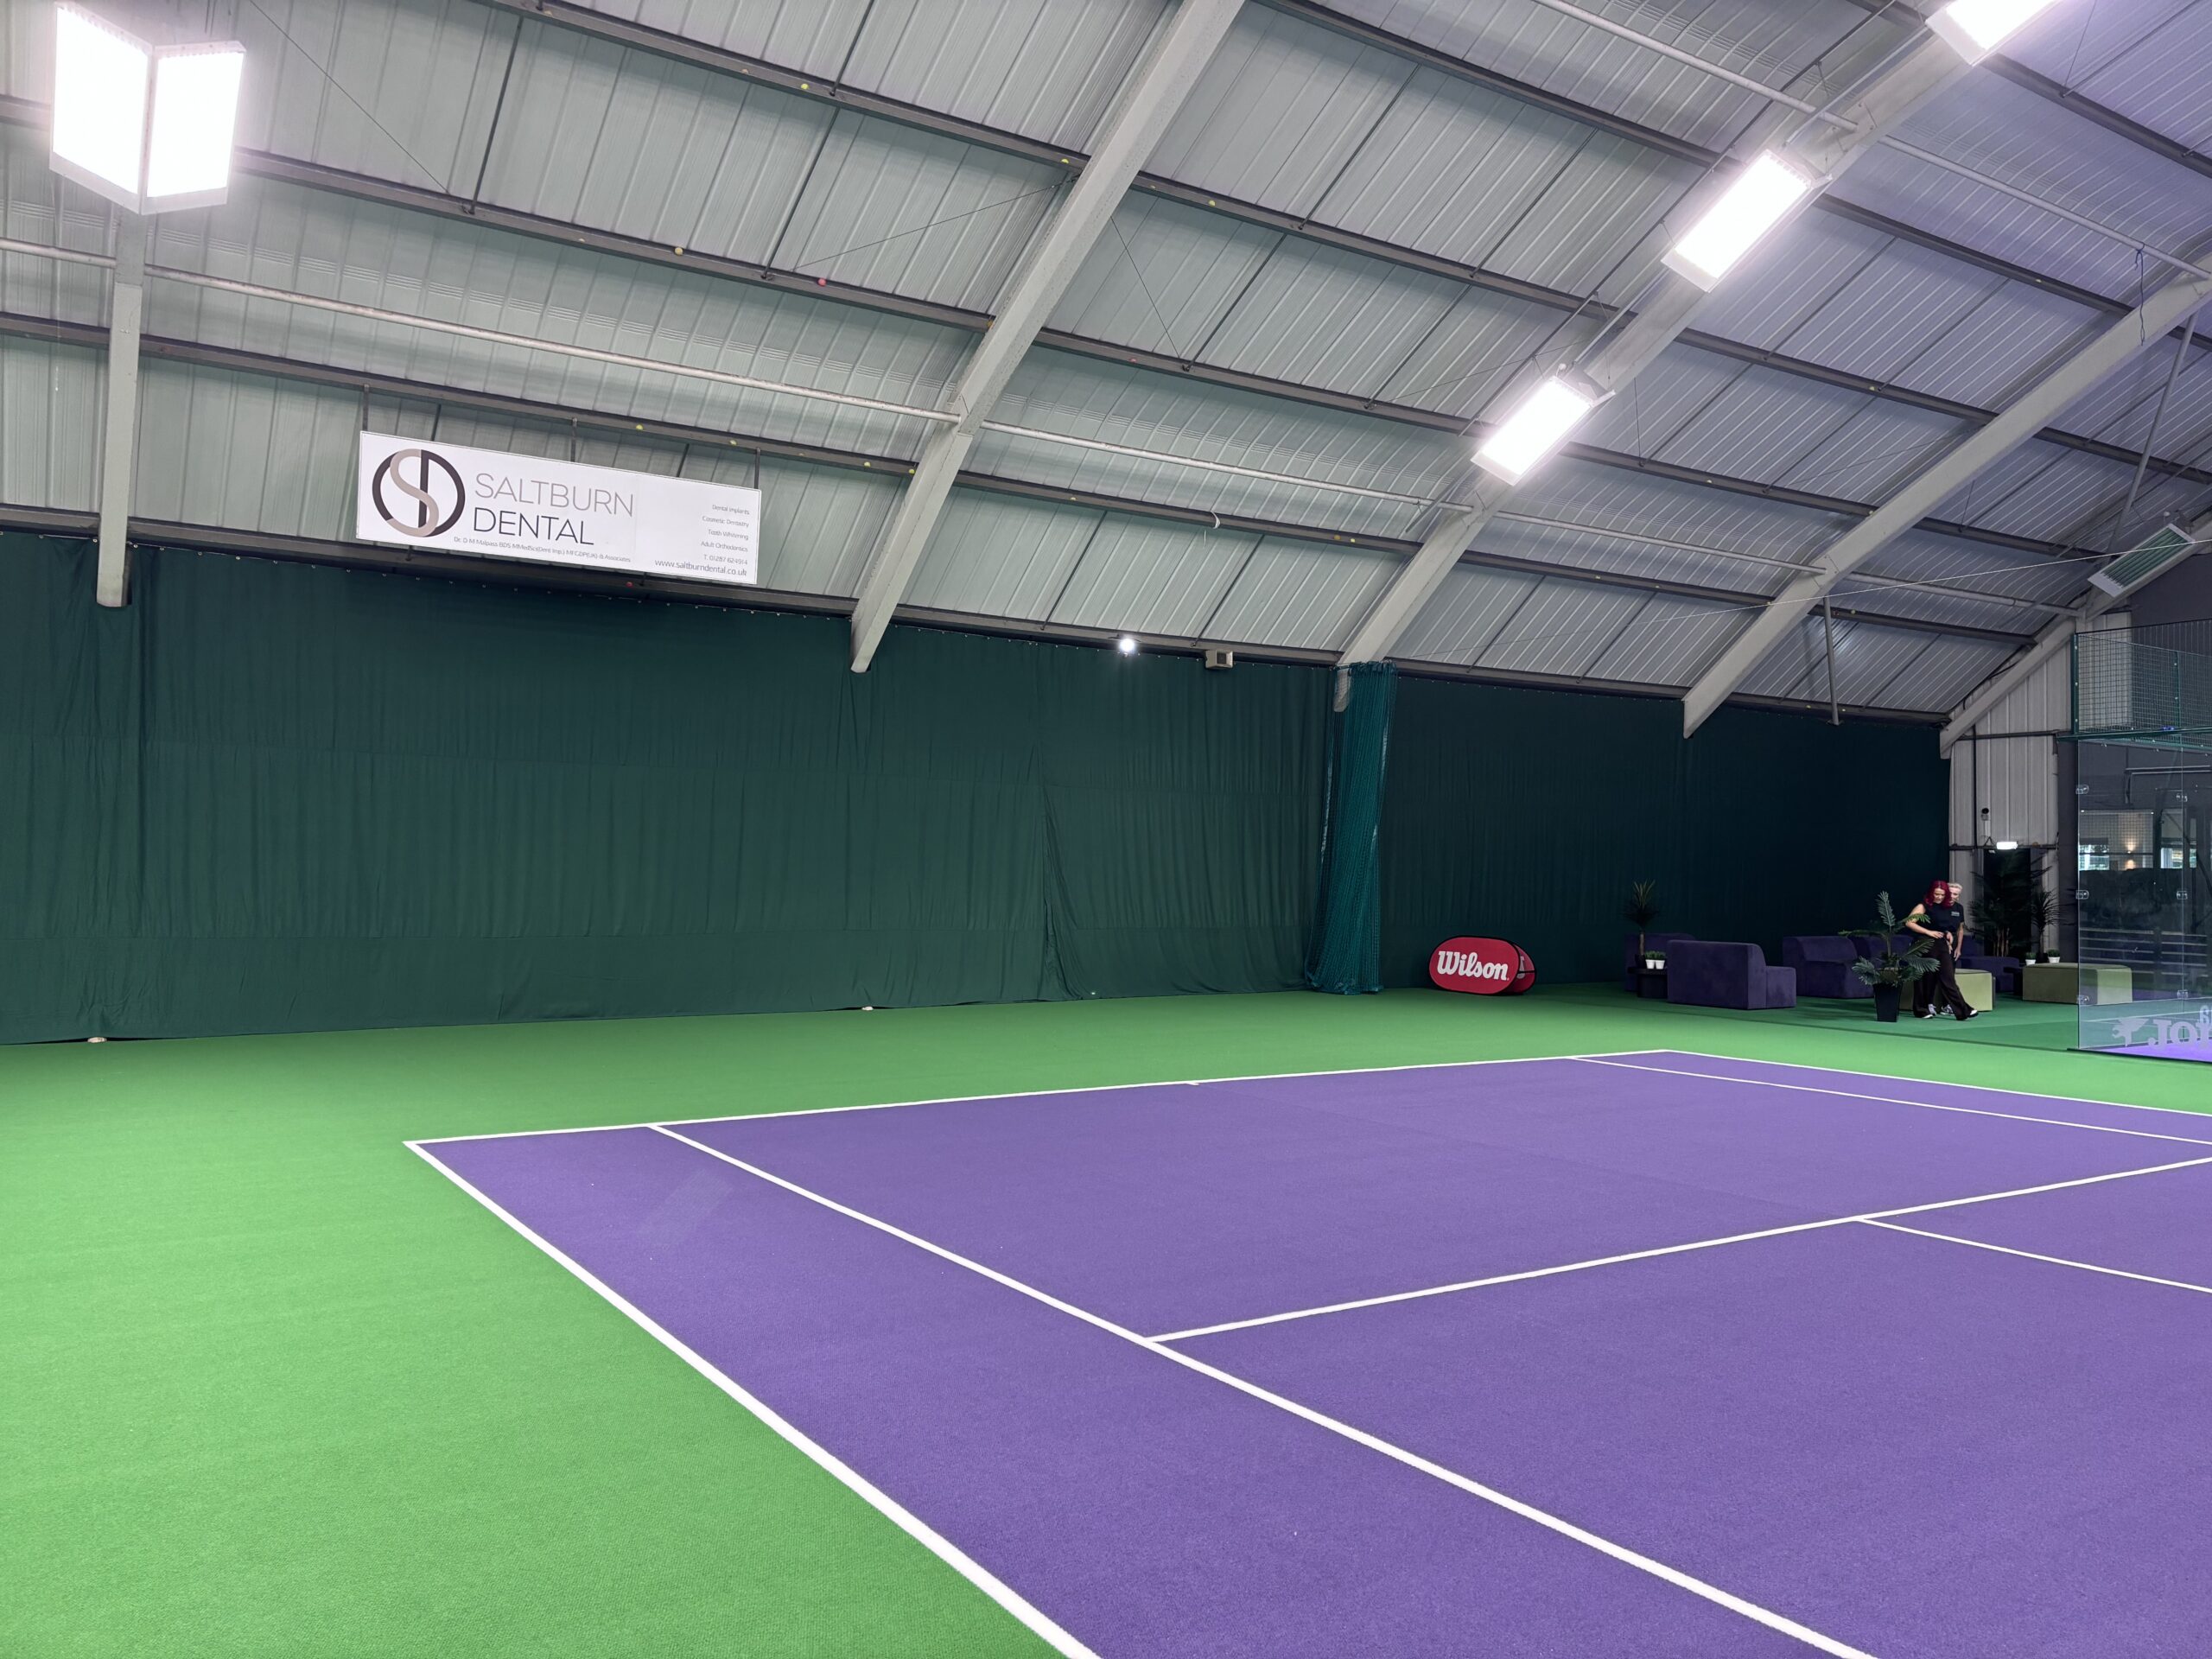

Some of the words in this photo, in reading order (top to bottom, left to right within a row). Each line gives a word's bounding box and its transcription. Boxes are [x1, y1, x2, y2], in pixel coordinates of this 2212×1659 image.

[474, 473, 634, 518] SALTBURN
[473, 506, 594, 545] DENTAL
[702, 515, 726, 524] Cosmetic
[727, 519, 749, 528] Dentistry
[722, 531, 749, 540] Whitening
[715, 543, 748, 552] Orthodontics
[604, 554, 631, 563] Associates
[654, 560, 747, 576] www.saltburndental.co.uk
[1436, 950, 1508, 981] Wilson
